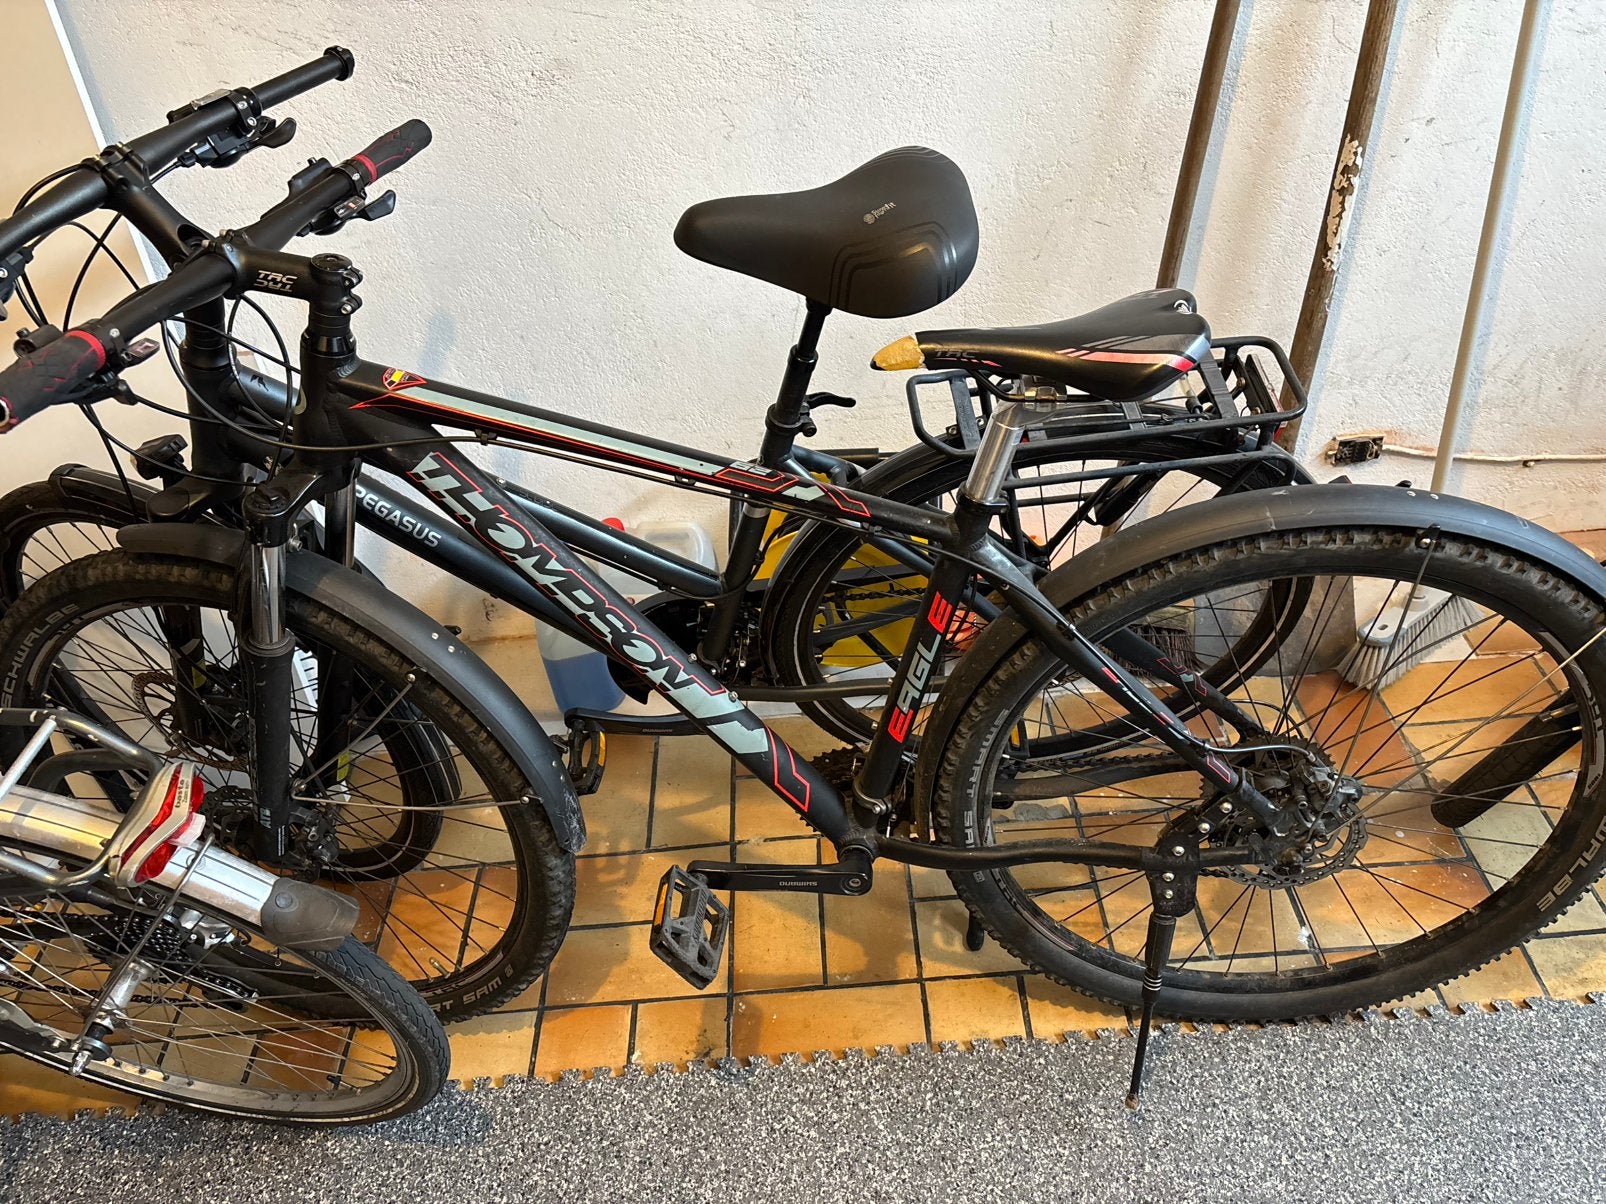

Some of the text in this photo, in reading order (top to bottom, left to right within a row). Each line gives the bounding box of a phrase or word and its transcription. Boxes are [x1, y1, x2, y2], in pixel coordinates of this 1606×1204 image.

[355, 484, 442, 548] PEGASUS
[405, 451, 727, 695] THOMPSON
[1, 603, 80, 708] SCHWALBE
[887, 591, 953, 744] EAGLE
[175, 779, 185, 808] basta
[963, 708, 1010, 848] SMART SA
[462, 976, 503, 1005] SAM
